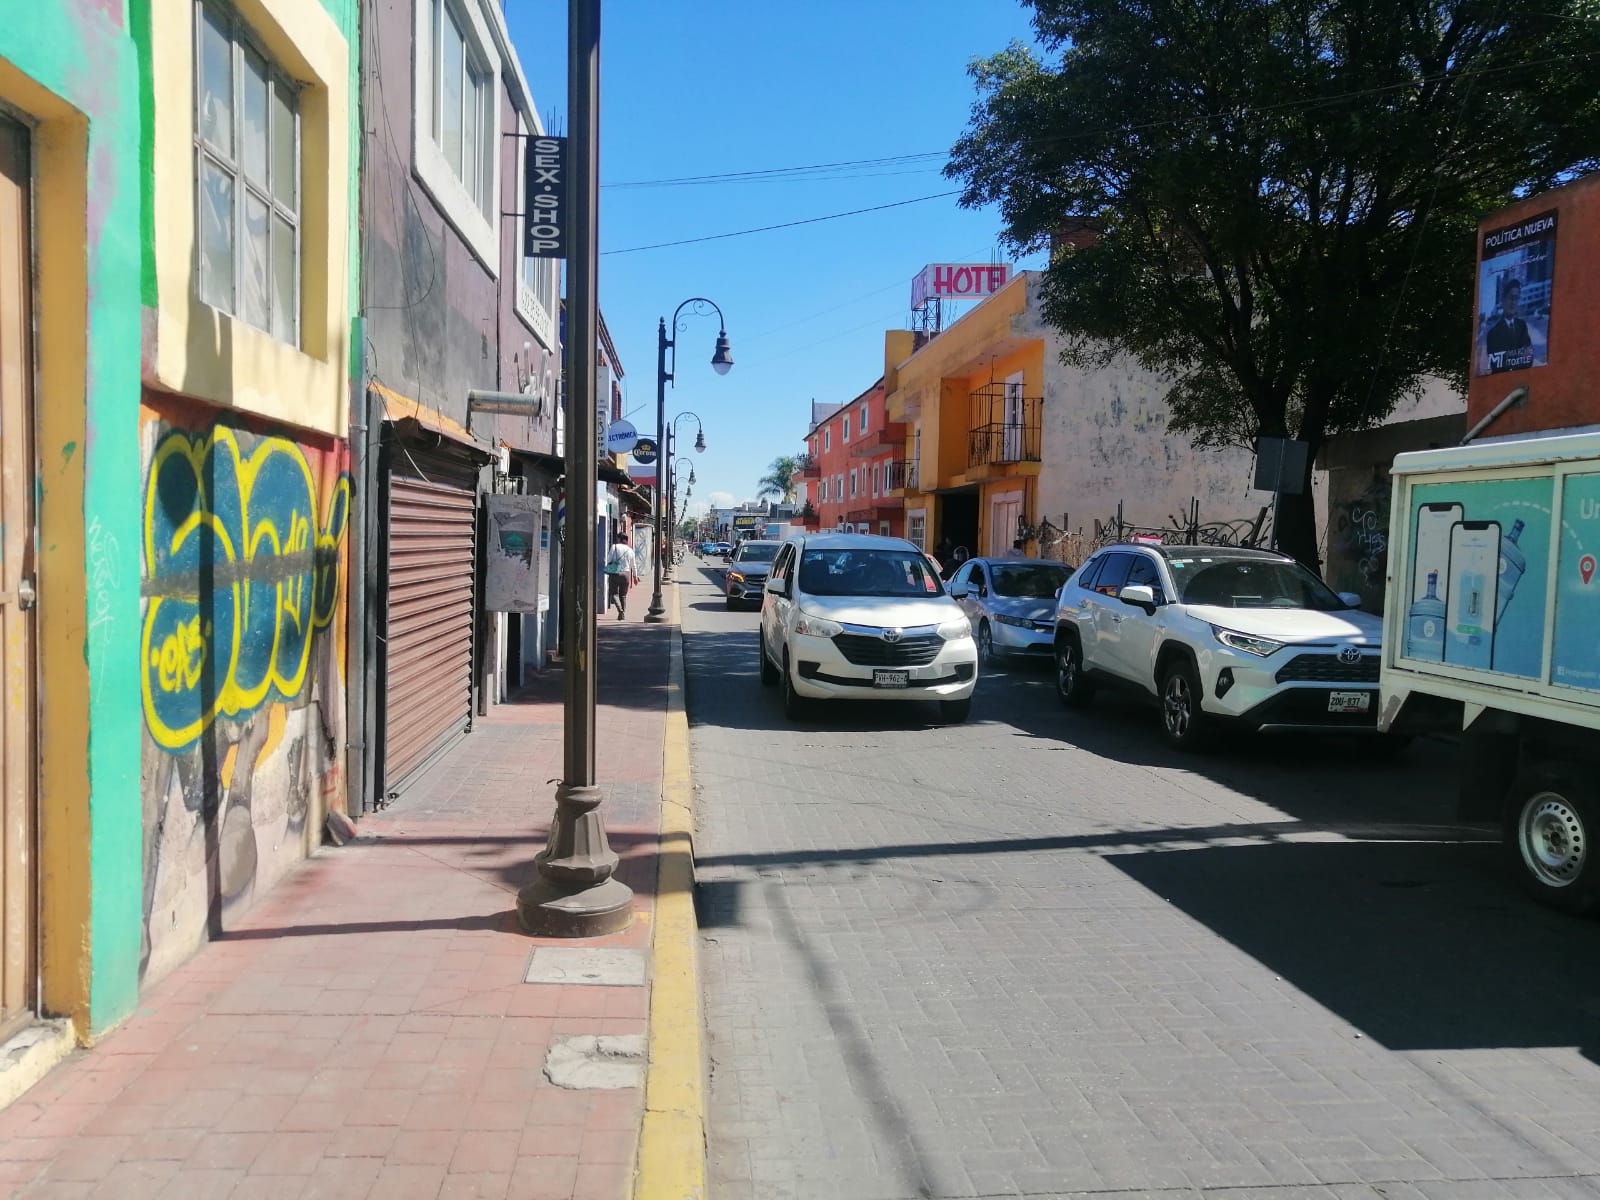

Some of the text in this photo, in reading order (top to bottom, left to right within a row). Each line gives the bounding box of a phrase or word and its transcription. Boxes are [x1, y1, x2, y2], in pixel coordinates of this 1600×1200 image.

[534, 139, 561, 184] SEX
[530, 194, 561, 254] SHOP
[1485, 216, 1554, 248] POLÍTICA NUEVA
